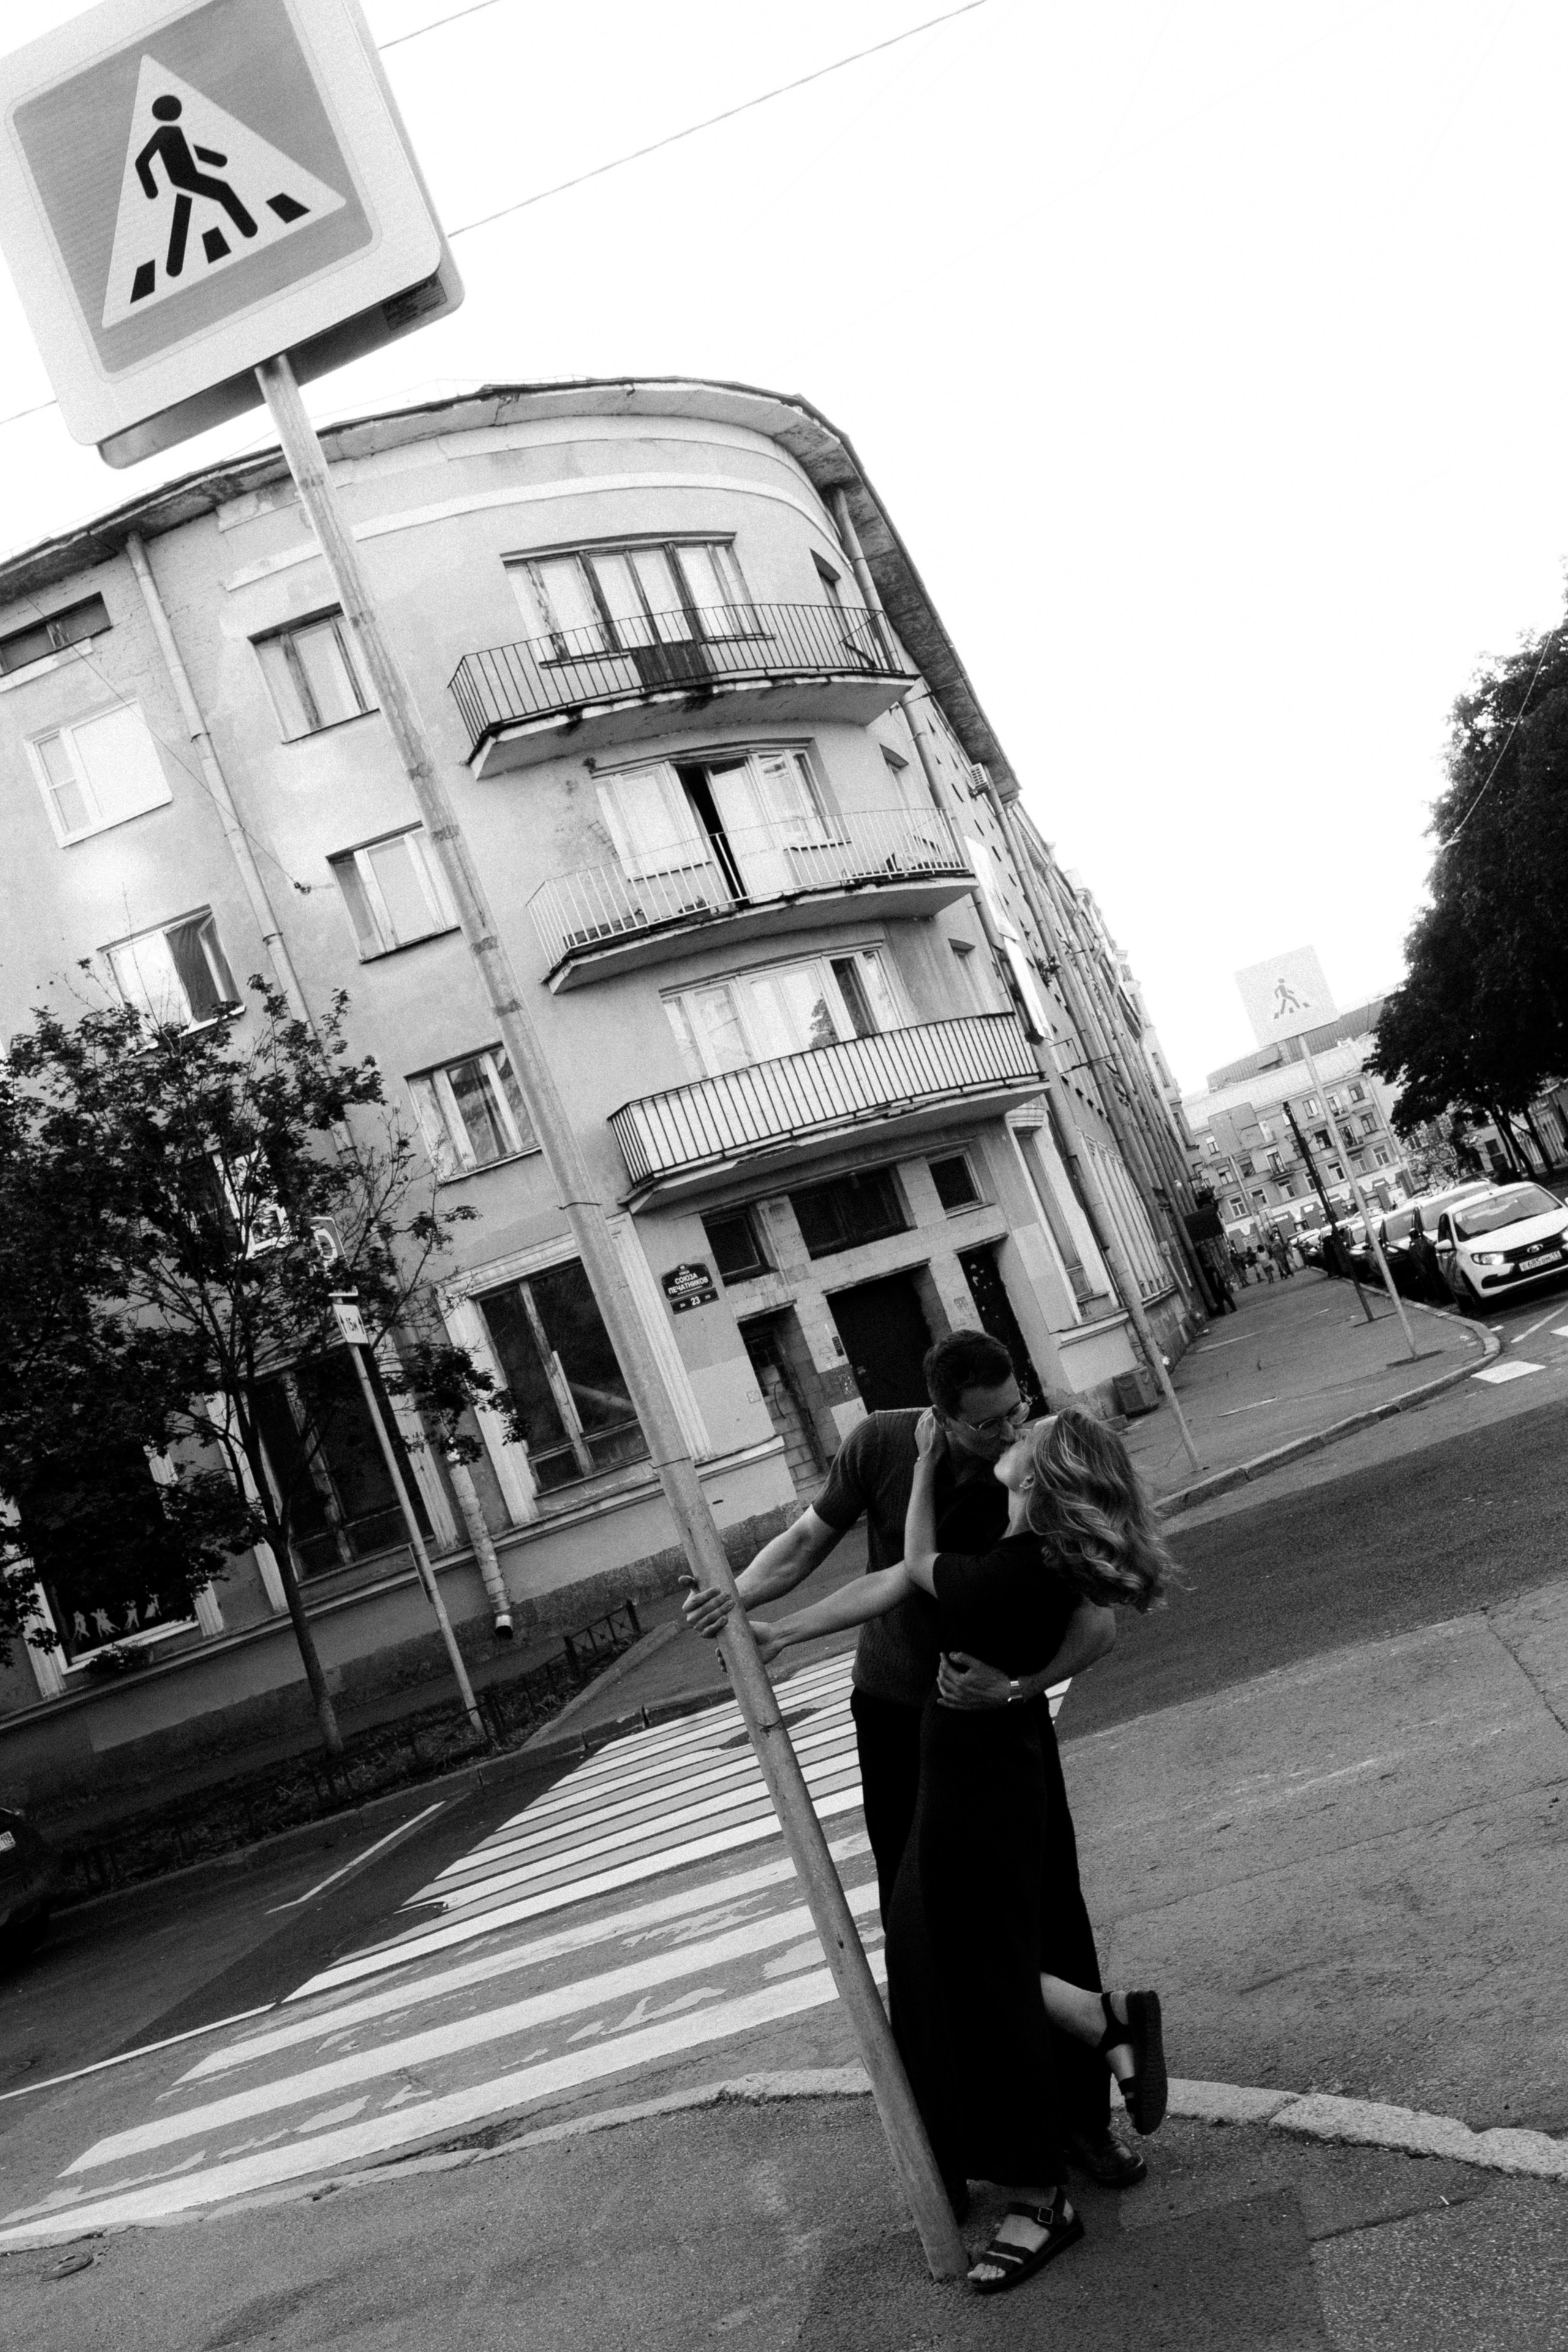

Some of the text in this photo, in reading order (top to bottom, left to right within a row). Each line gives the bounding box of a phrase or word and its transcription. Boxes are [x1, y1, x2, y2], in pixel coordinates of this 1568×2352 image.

[674, 1272, 698, 1284] СОЮЗА
[668, 1276, 709, 1295] ПЕЧАТНИКОВ
[690, 1296, 701, 1306] 23
